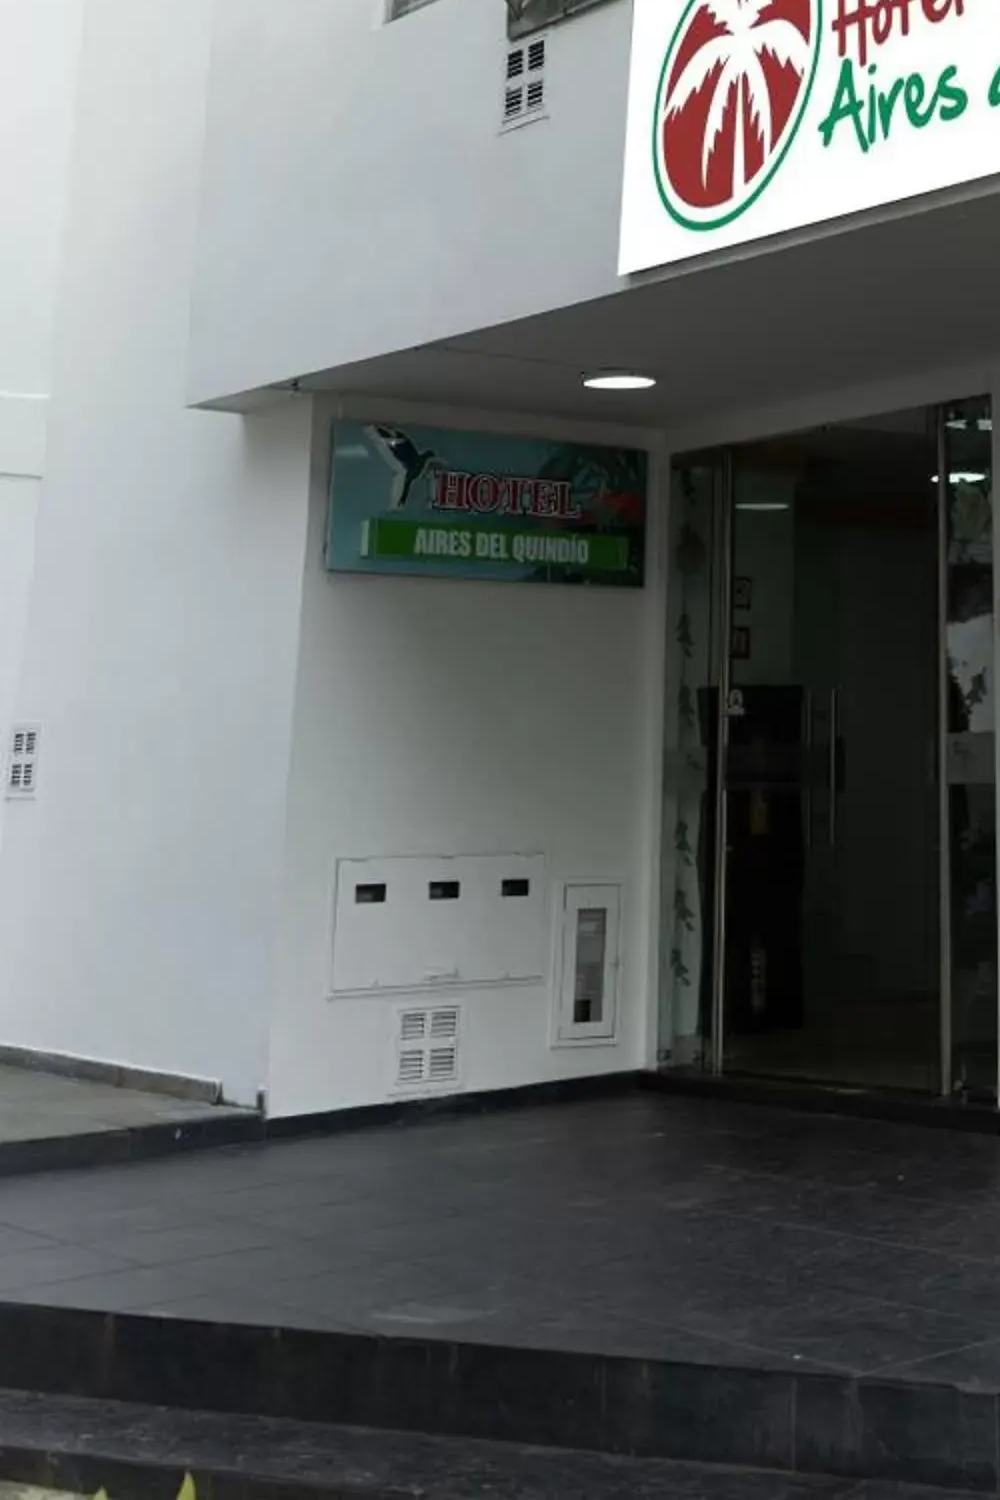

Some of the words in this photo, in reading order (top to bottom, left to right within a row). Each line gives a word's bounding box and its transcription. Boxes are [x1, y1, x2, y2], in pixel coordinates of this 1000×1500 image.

[818, 58, 968, 152] Aires
[431, 470, 583, 519] HOTEL
[414, 528, 472, 557] AIRES
[476, 532, 509, 559] DEL
[512, 534, 589, 563] QUINDÍO
